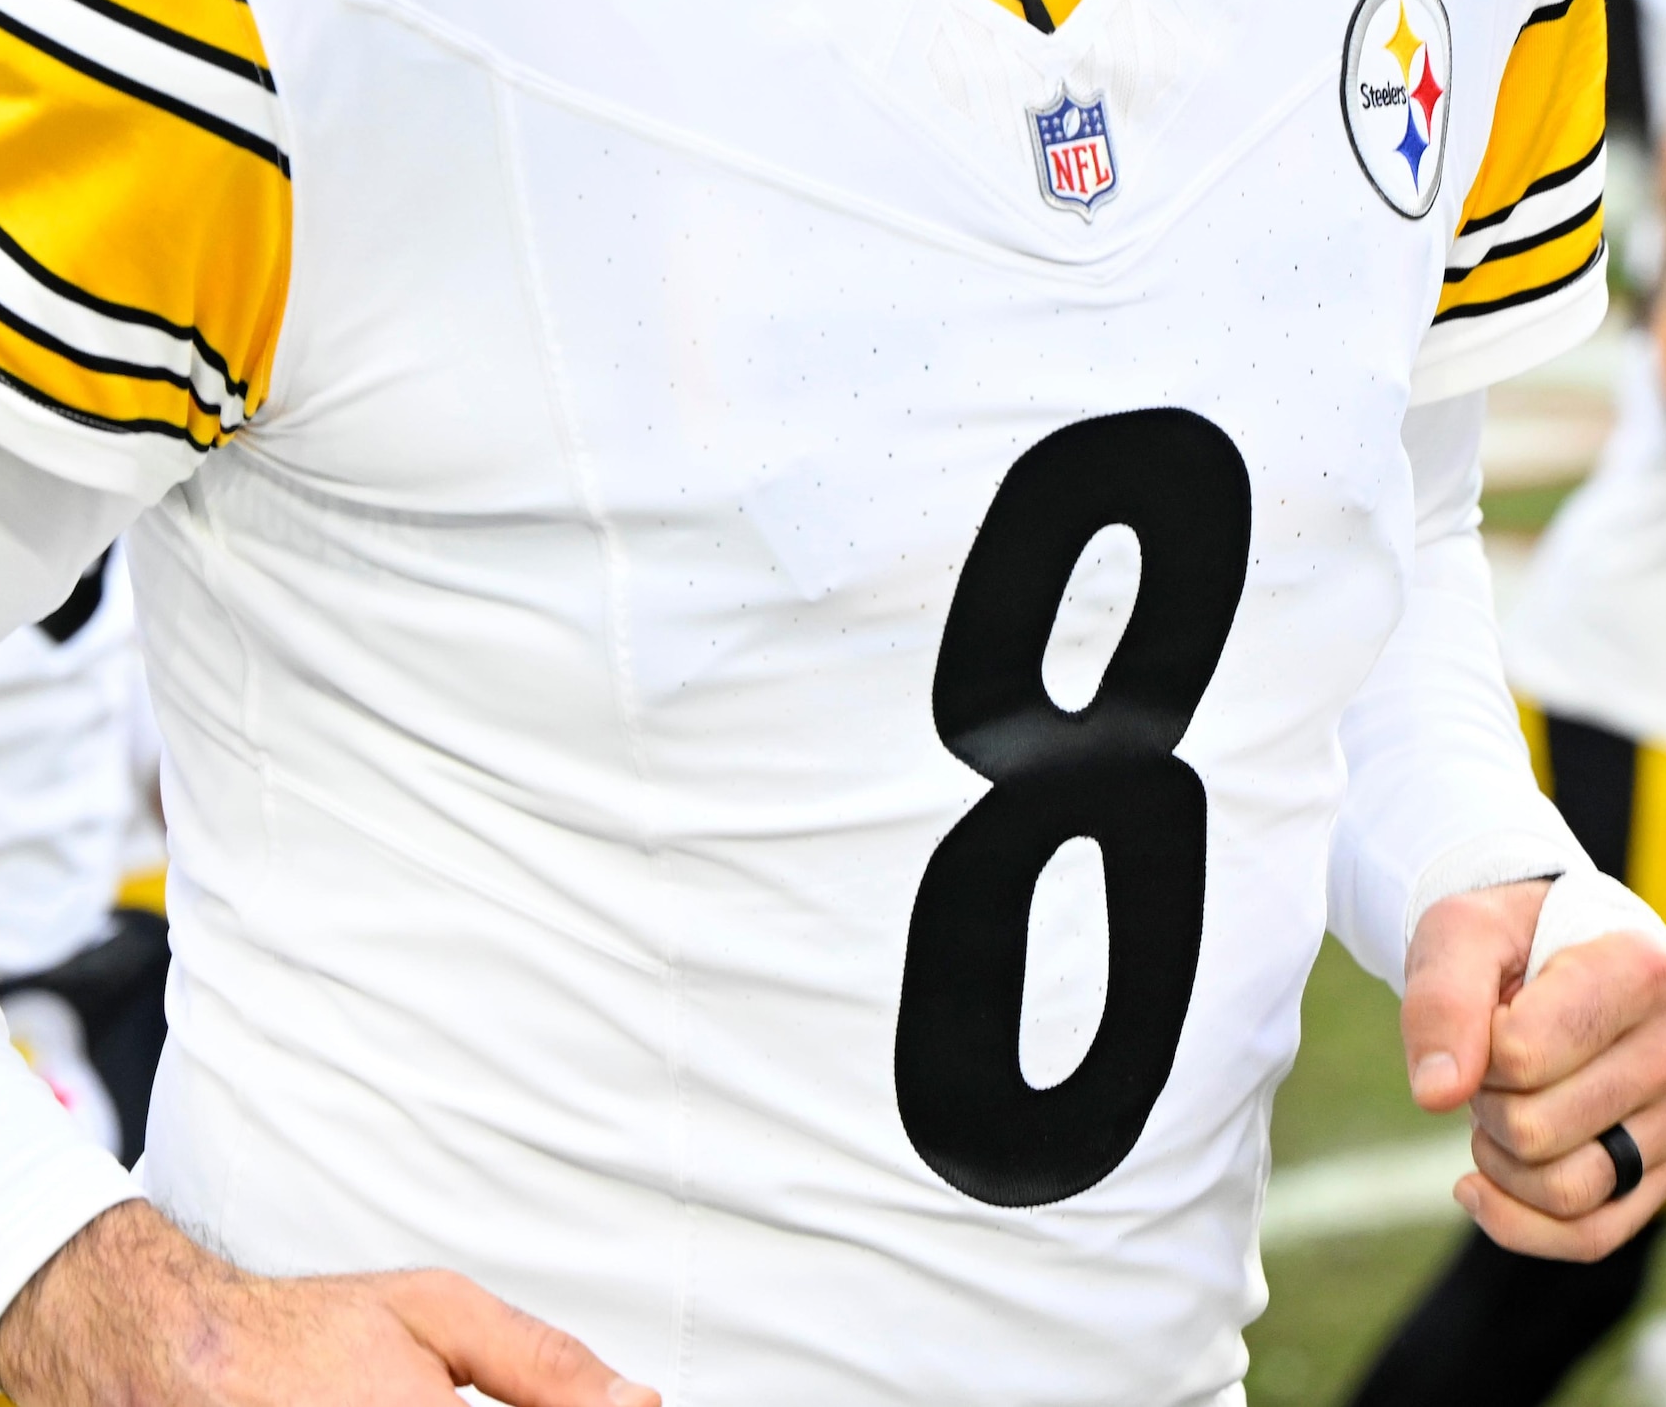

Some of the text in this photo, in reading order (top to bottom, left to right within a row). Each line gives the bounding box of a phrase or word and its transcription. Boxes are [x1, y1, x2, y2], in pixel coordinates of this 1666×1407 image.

[1359, 80, 1408, 111] Steelers
[1050, 142, 1111, 195] NFL
[894, 407, 1252, 1208] 8
